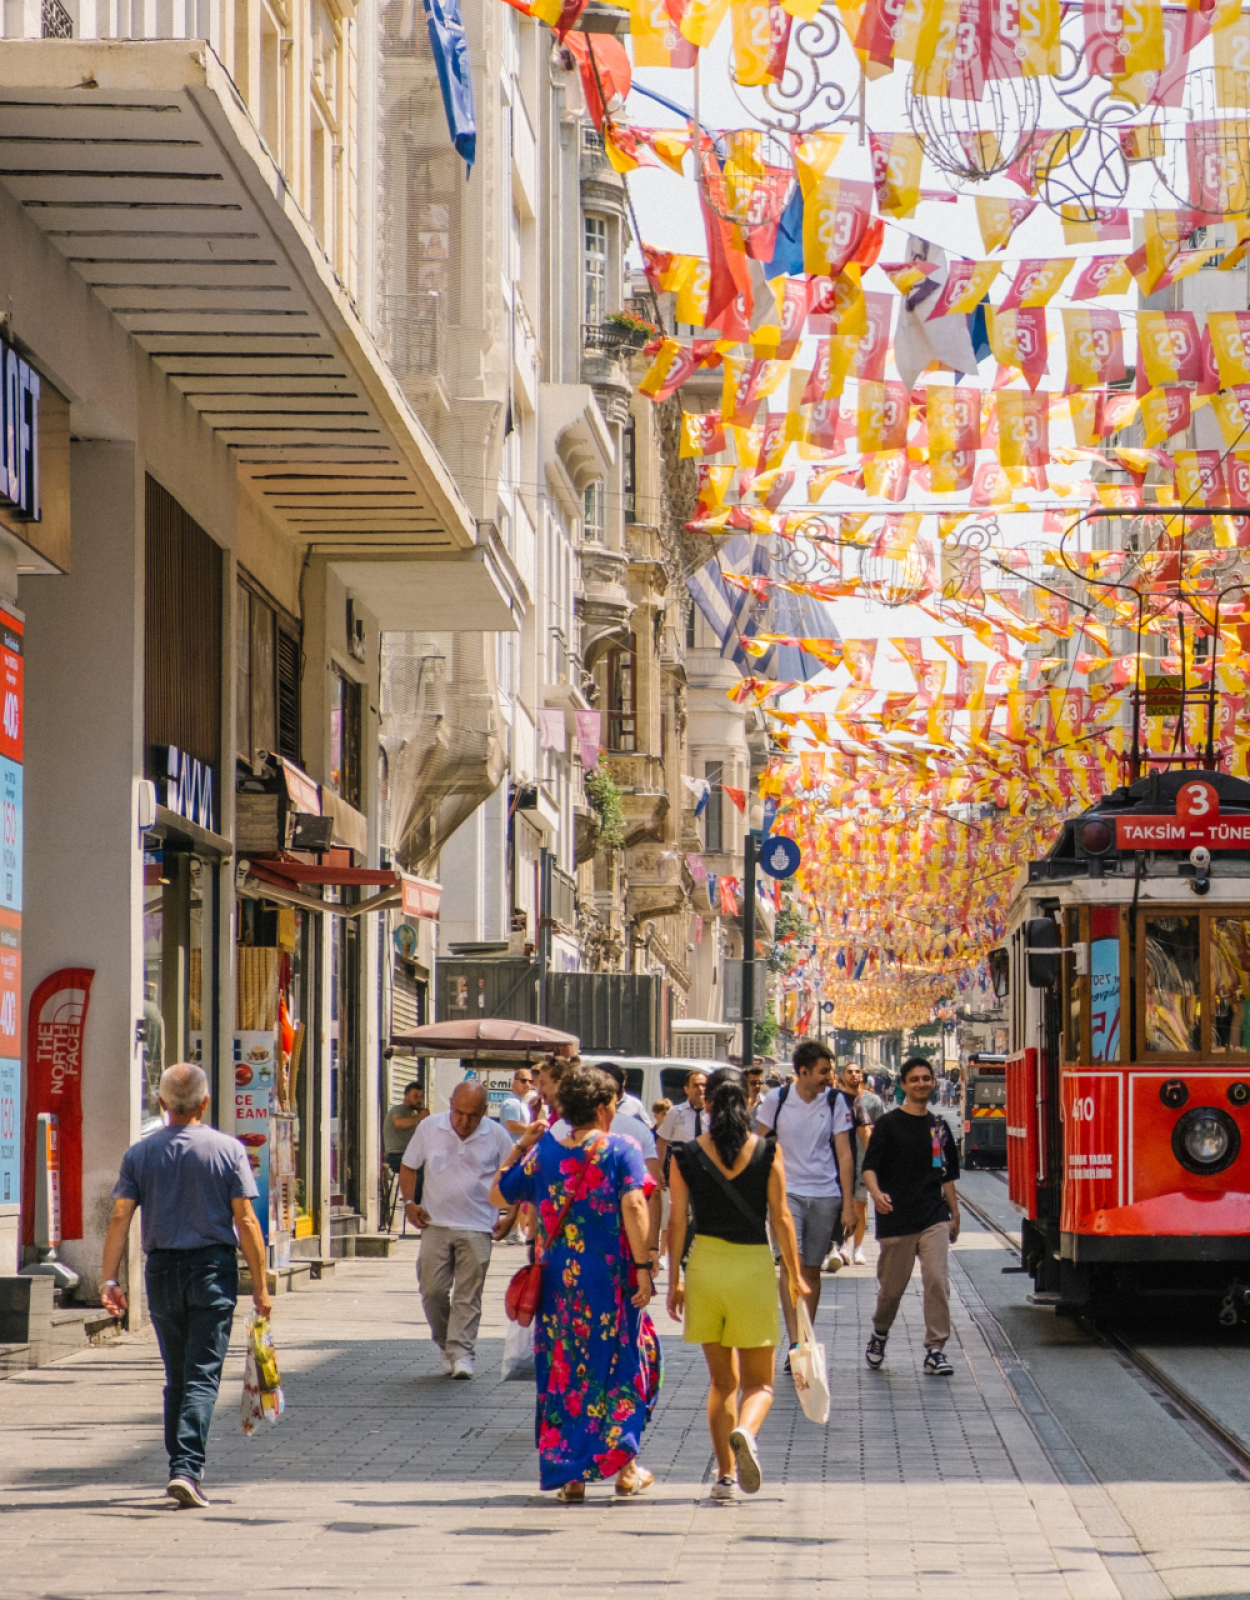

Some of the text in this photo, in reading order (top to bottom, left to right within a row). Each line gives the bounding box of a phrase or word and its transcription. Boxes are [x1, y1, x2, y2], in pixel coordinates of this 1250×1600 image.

[819, 210, 853, 243] 23
[1003, 326, 1032, 351] 23
[1079, 331, 1109, 356] 23
[1155, 331, 1186, 357] 23
[871, 401, 897, 426] 23
[941, 403, 969, 428] 23
[1011, 414, 1040, 442] 23
[1188, 468, 1215, 491] 23
[1151, 706, 1176, 716] VOLT
[1187, 785, 1210, 816] 3
[1123, 823, 1186, 840] TAKSİM
[37, 1024, 54, 1063] THE
[65, 1024, 80, 1076] FACE
[50, 1024, 69, 1095] NORTH
[235, 1095, 253, 1106] CE
[1072, 1096, 1095, 1121] 410
[236, 1108, 268, 1120] EAM
[1089, 1154, 1112, 1165] YASAK
